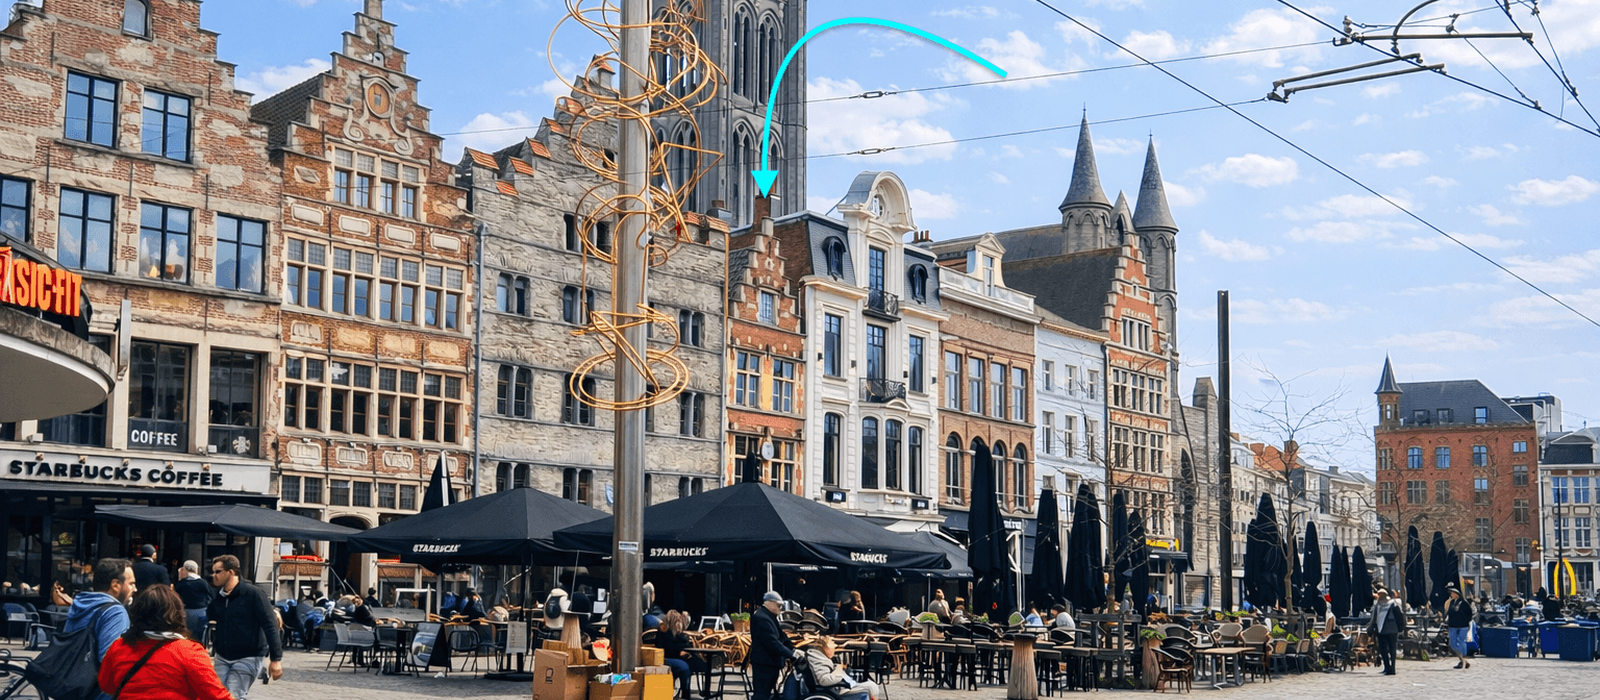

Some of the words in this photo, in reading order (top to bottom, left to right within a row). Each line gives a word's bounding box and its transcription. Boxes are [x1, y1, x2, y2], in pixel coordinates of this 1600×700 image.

[0, 246, 82, 317] ASIC-FIT
[131, 429, 178, 446] COFFEE
[10, 460, 142, 481] STARBUCKS
[148, 469, 223, 487] COFFEE
